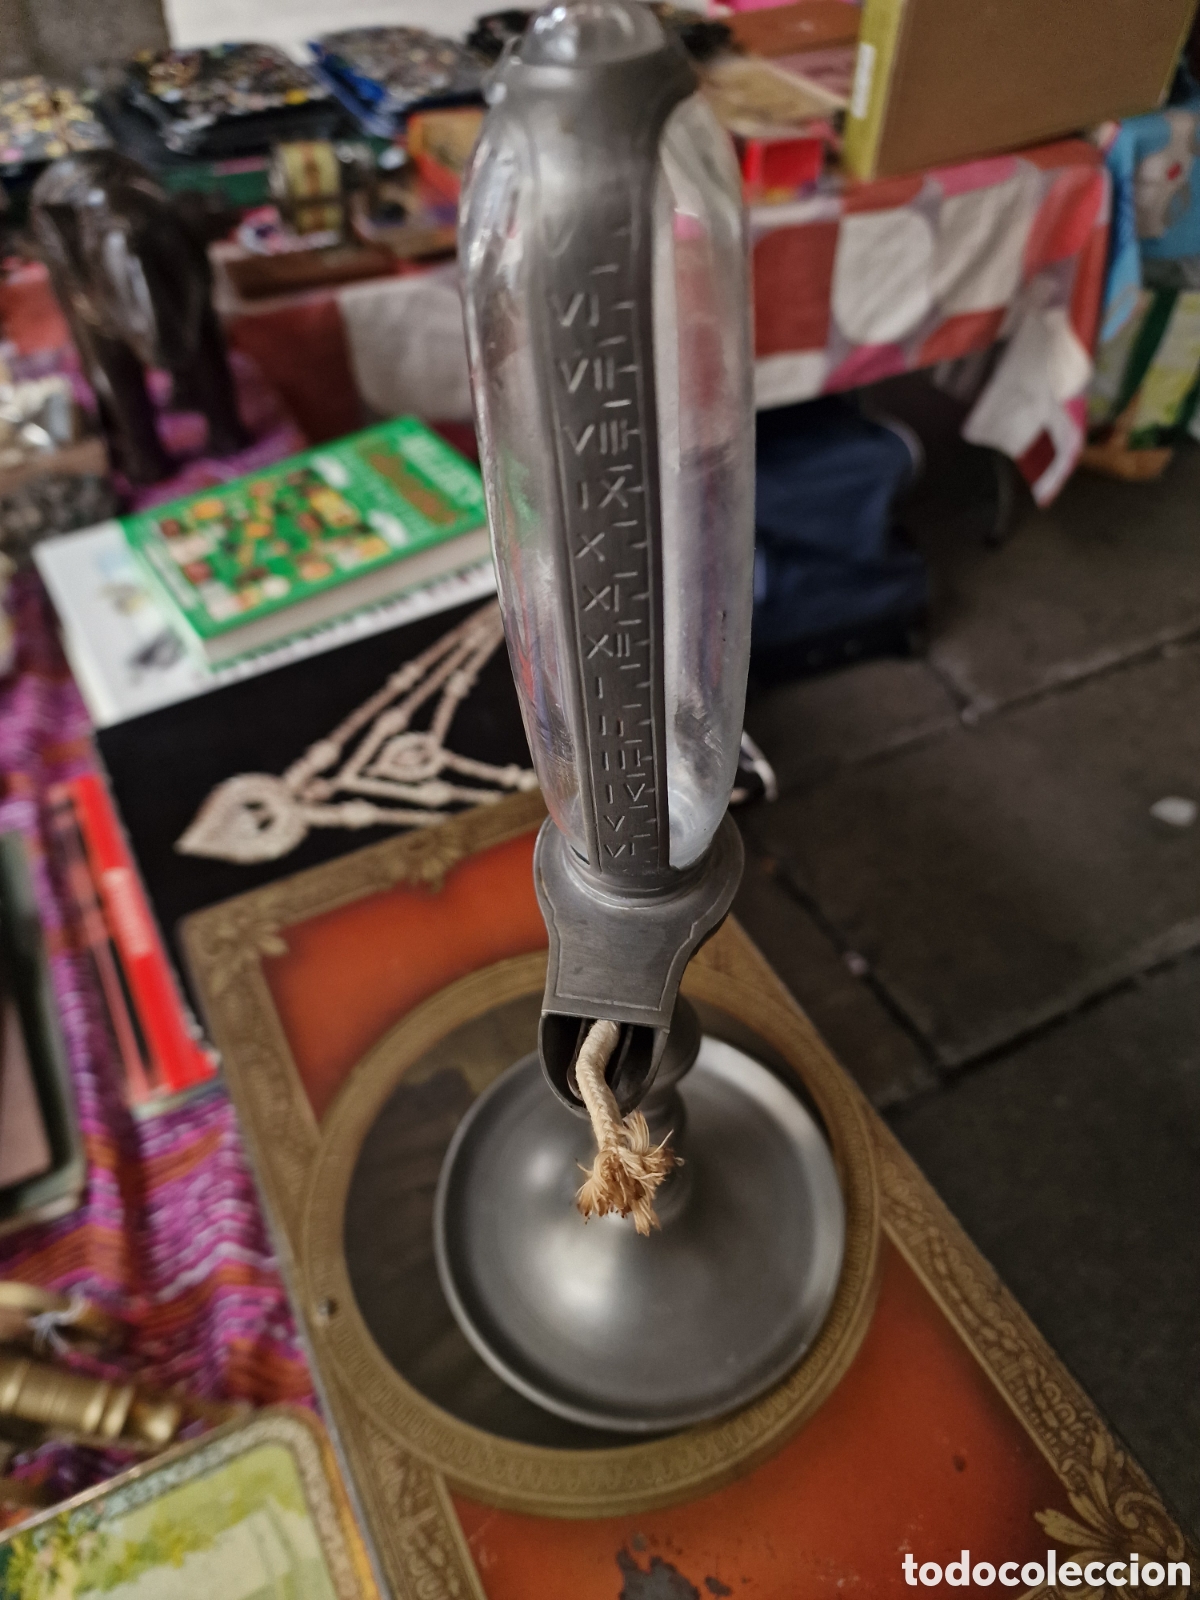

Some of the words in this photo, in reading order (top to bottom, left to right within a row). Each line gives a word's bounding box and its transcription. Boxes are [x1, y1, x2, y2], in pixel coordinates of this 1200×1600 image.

[552, 291, 600, 328] VI
[559, 357, 615, 394] VII
[562, 418, 629, 456] VIII
[580, 475, 629, 510] IX
[574, 532, 606, 563] X
[583, 583, 620, 613] XI
[583, 633, 631, 660] XII
[604, 749, 642, 772] III
[607, 782, 646, 804] IV
[605, 815, 626, 833] V
